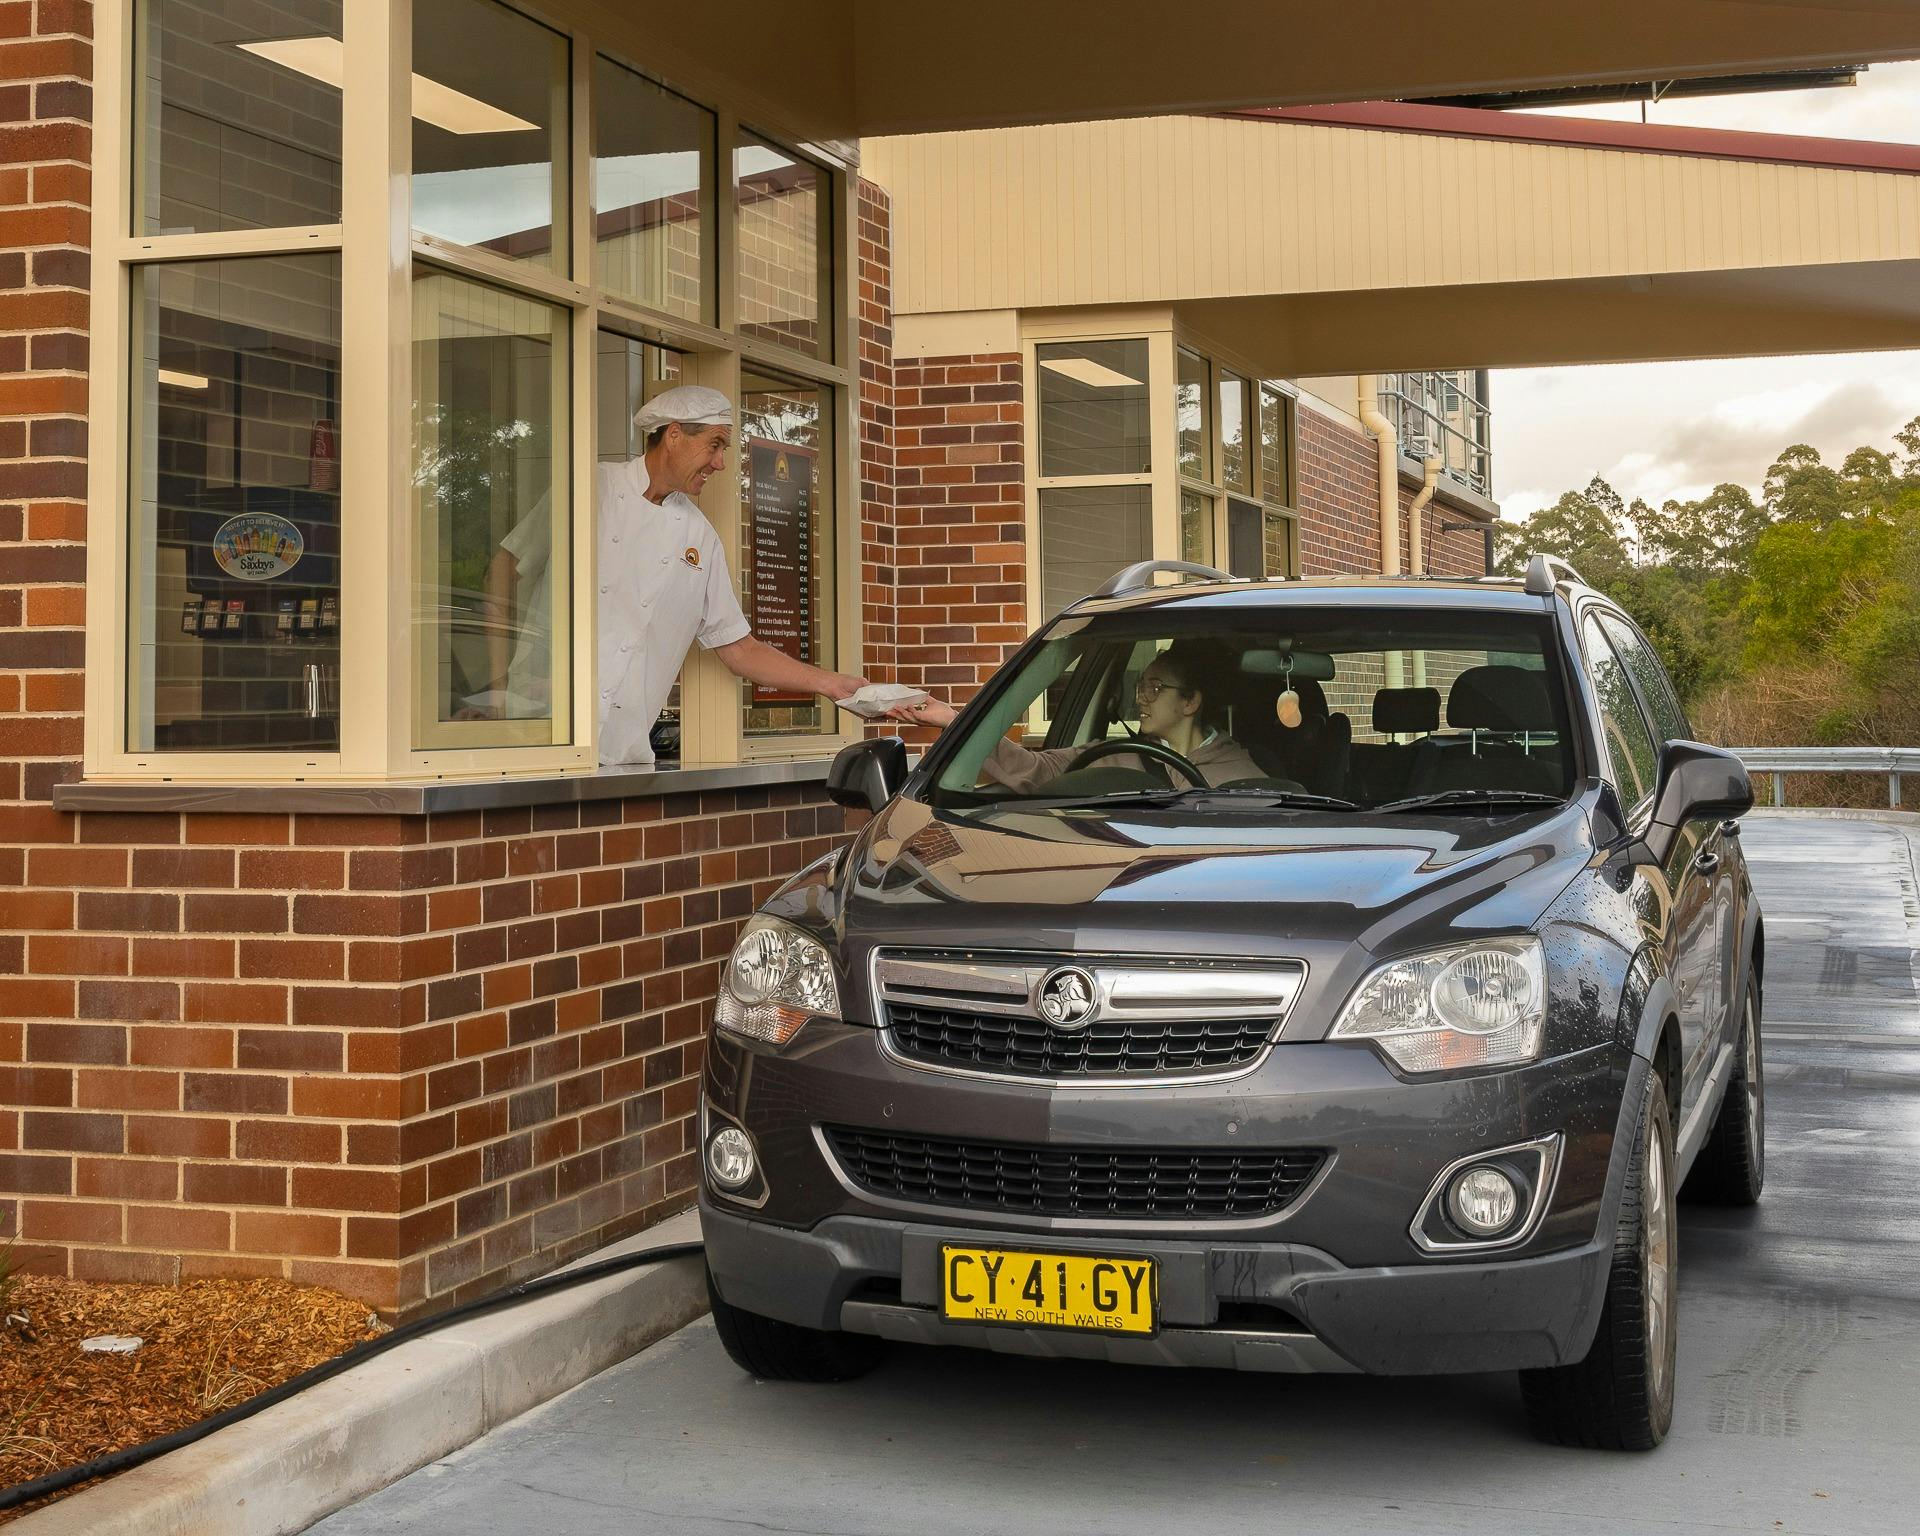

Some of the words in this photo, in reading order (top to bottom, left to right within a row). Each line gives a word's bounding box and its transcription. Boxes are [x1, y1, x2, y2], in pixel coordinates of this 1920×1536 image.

[240, 558, 274, 570] Saxbys
[950, 1255, 1005, 1304] CY
[1022, 1260, 1067, 1310] 41
[1092, 1264, 1146, 1314] GY
[974, 1308, 1008, 1320] NEW
[1016, 1310, 1064, 1324] SOUTH
[1074, 1314, 1123, 1328] WALES
